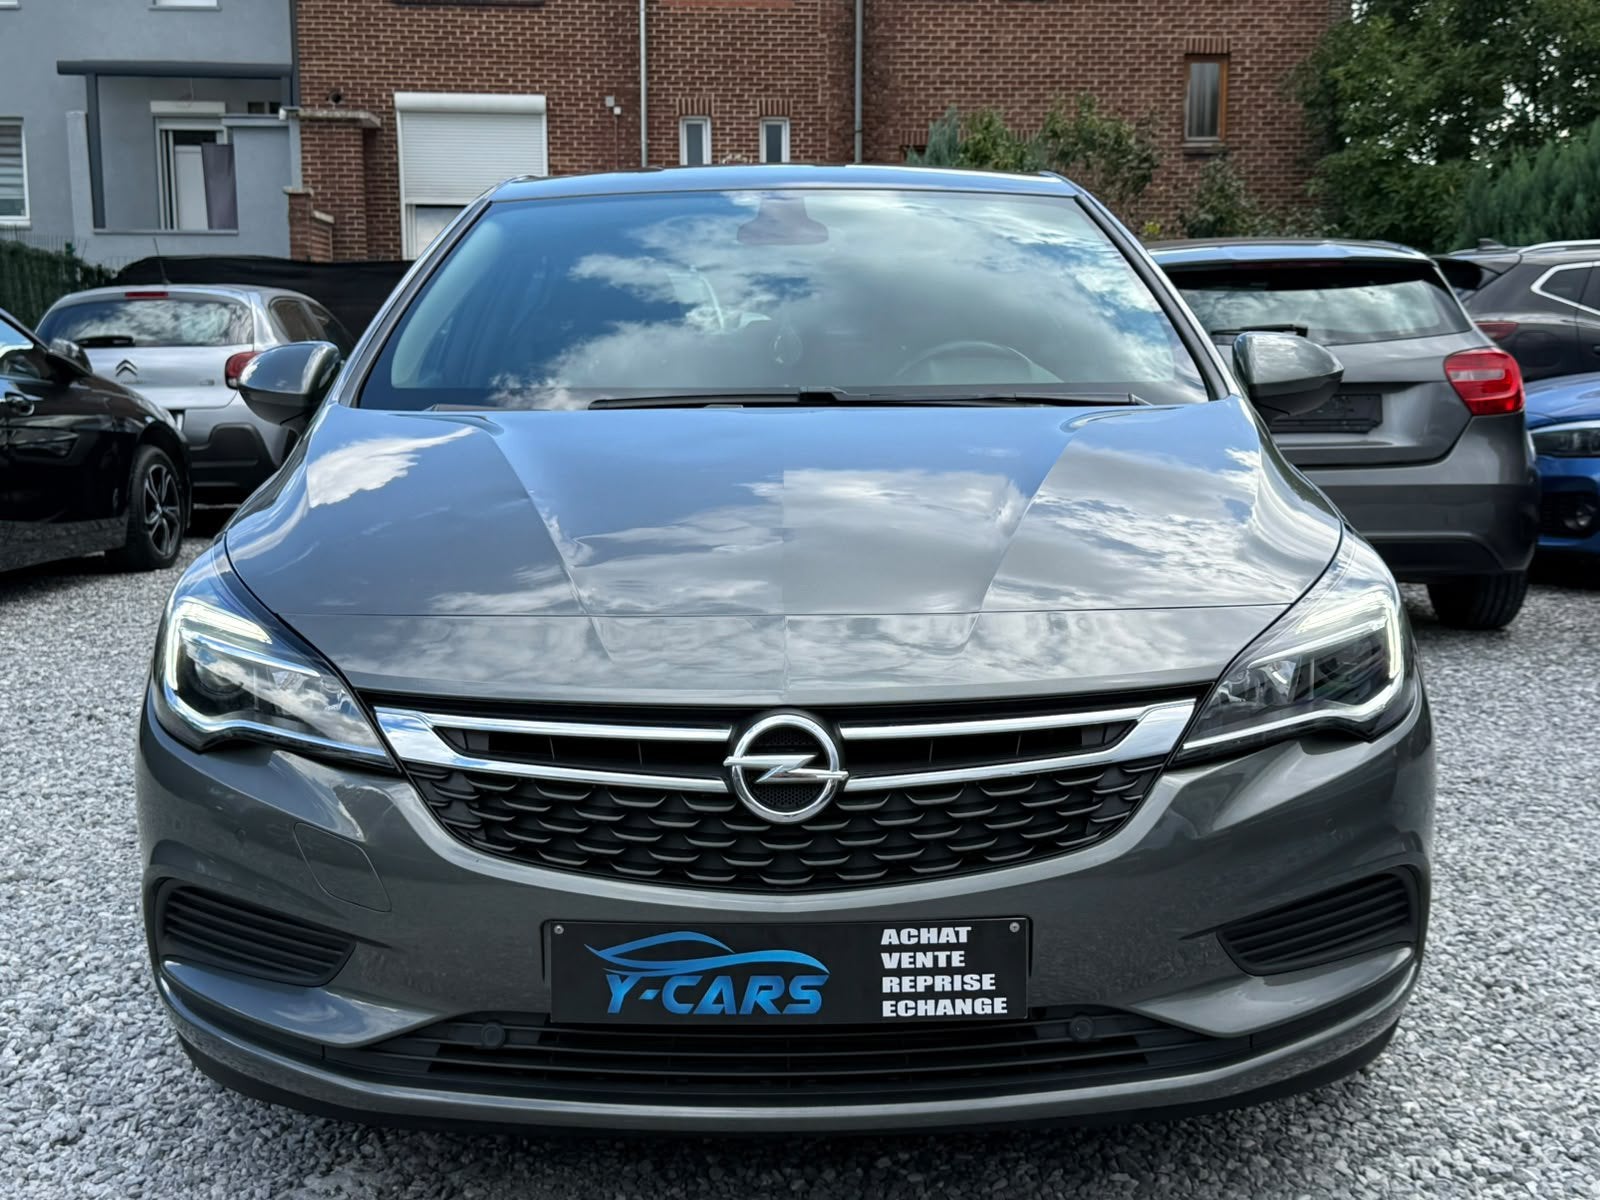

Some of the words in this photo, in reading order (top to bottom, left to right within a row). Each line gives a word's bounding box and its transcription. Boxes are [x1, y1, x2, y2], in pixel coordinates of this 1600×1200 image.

[880, 926, 972, 946] ACHAT
[880, 950, 966, 969] VENTE
[881, 973, 997, 993] REPRISE
[606, 974, 826, 1016] Y-CARS
[881, 997, 1008, 1018] ECHANGE
